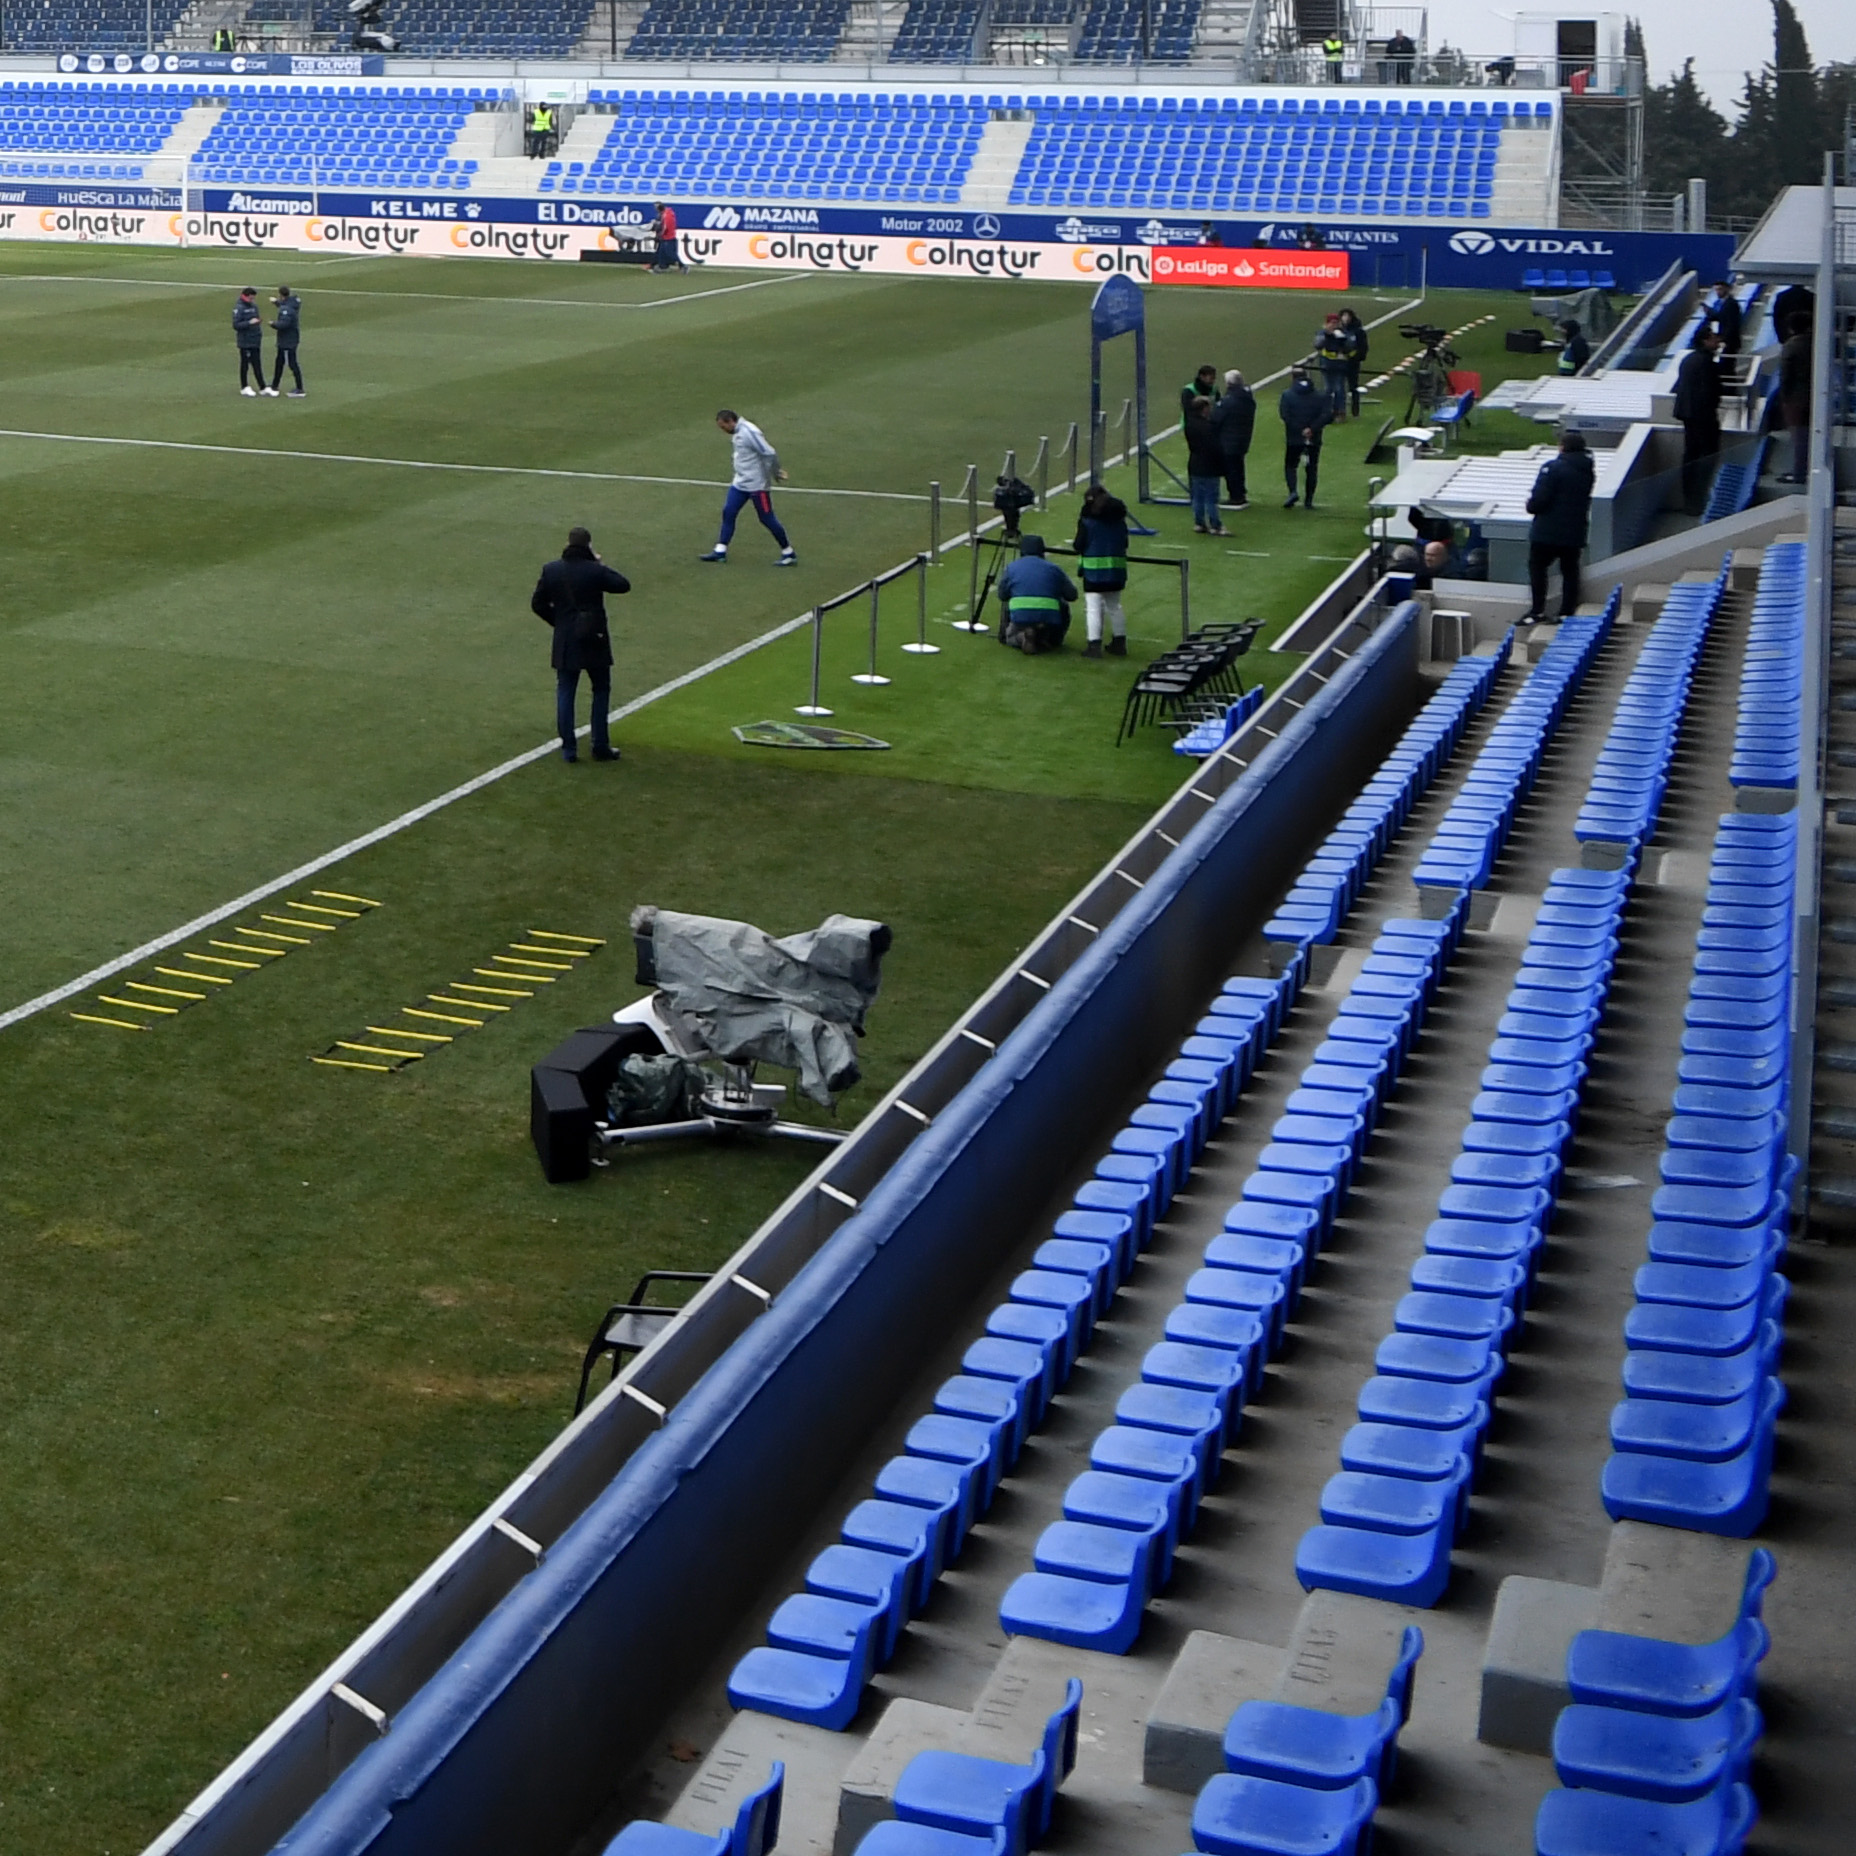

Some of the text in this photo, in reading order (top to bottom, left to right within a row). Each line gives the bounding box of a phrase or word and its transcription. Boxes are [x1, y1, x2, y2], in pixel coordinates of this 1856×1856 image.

[228, 193, 312, 215] Alcampo
[371, 200, 458, 218] KELME
[744, 208, 819, 224] MAZANA
[882, 217, 964, 233] Motor 2002
[169, 213, 278, 246] Colnatur
[305, 218, 419, 252] Colnatur
[1329, 230, 1399, 243] INFANTES
[451, 224, 569, 258] Colnatur
[1496, 238, 1613, 256] VIDAL
[749, 234, 879, 270] Colnatur
[906, 240, 1041, 277] Colnatur
[1177, 258, 1342, 279] LaLiga Santander
